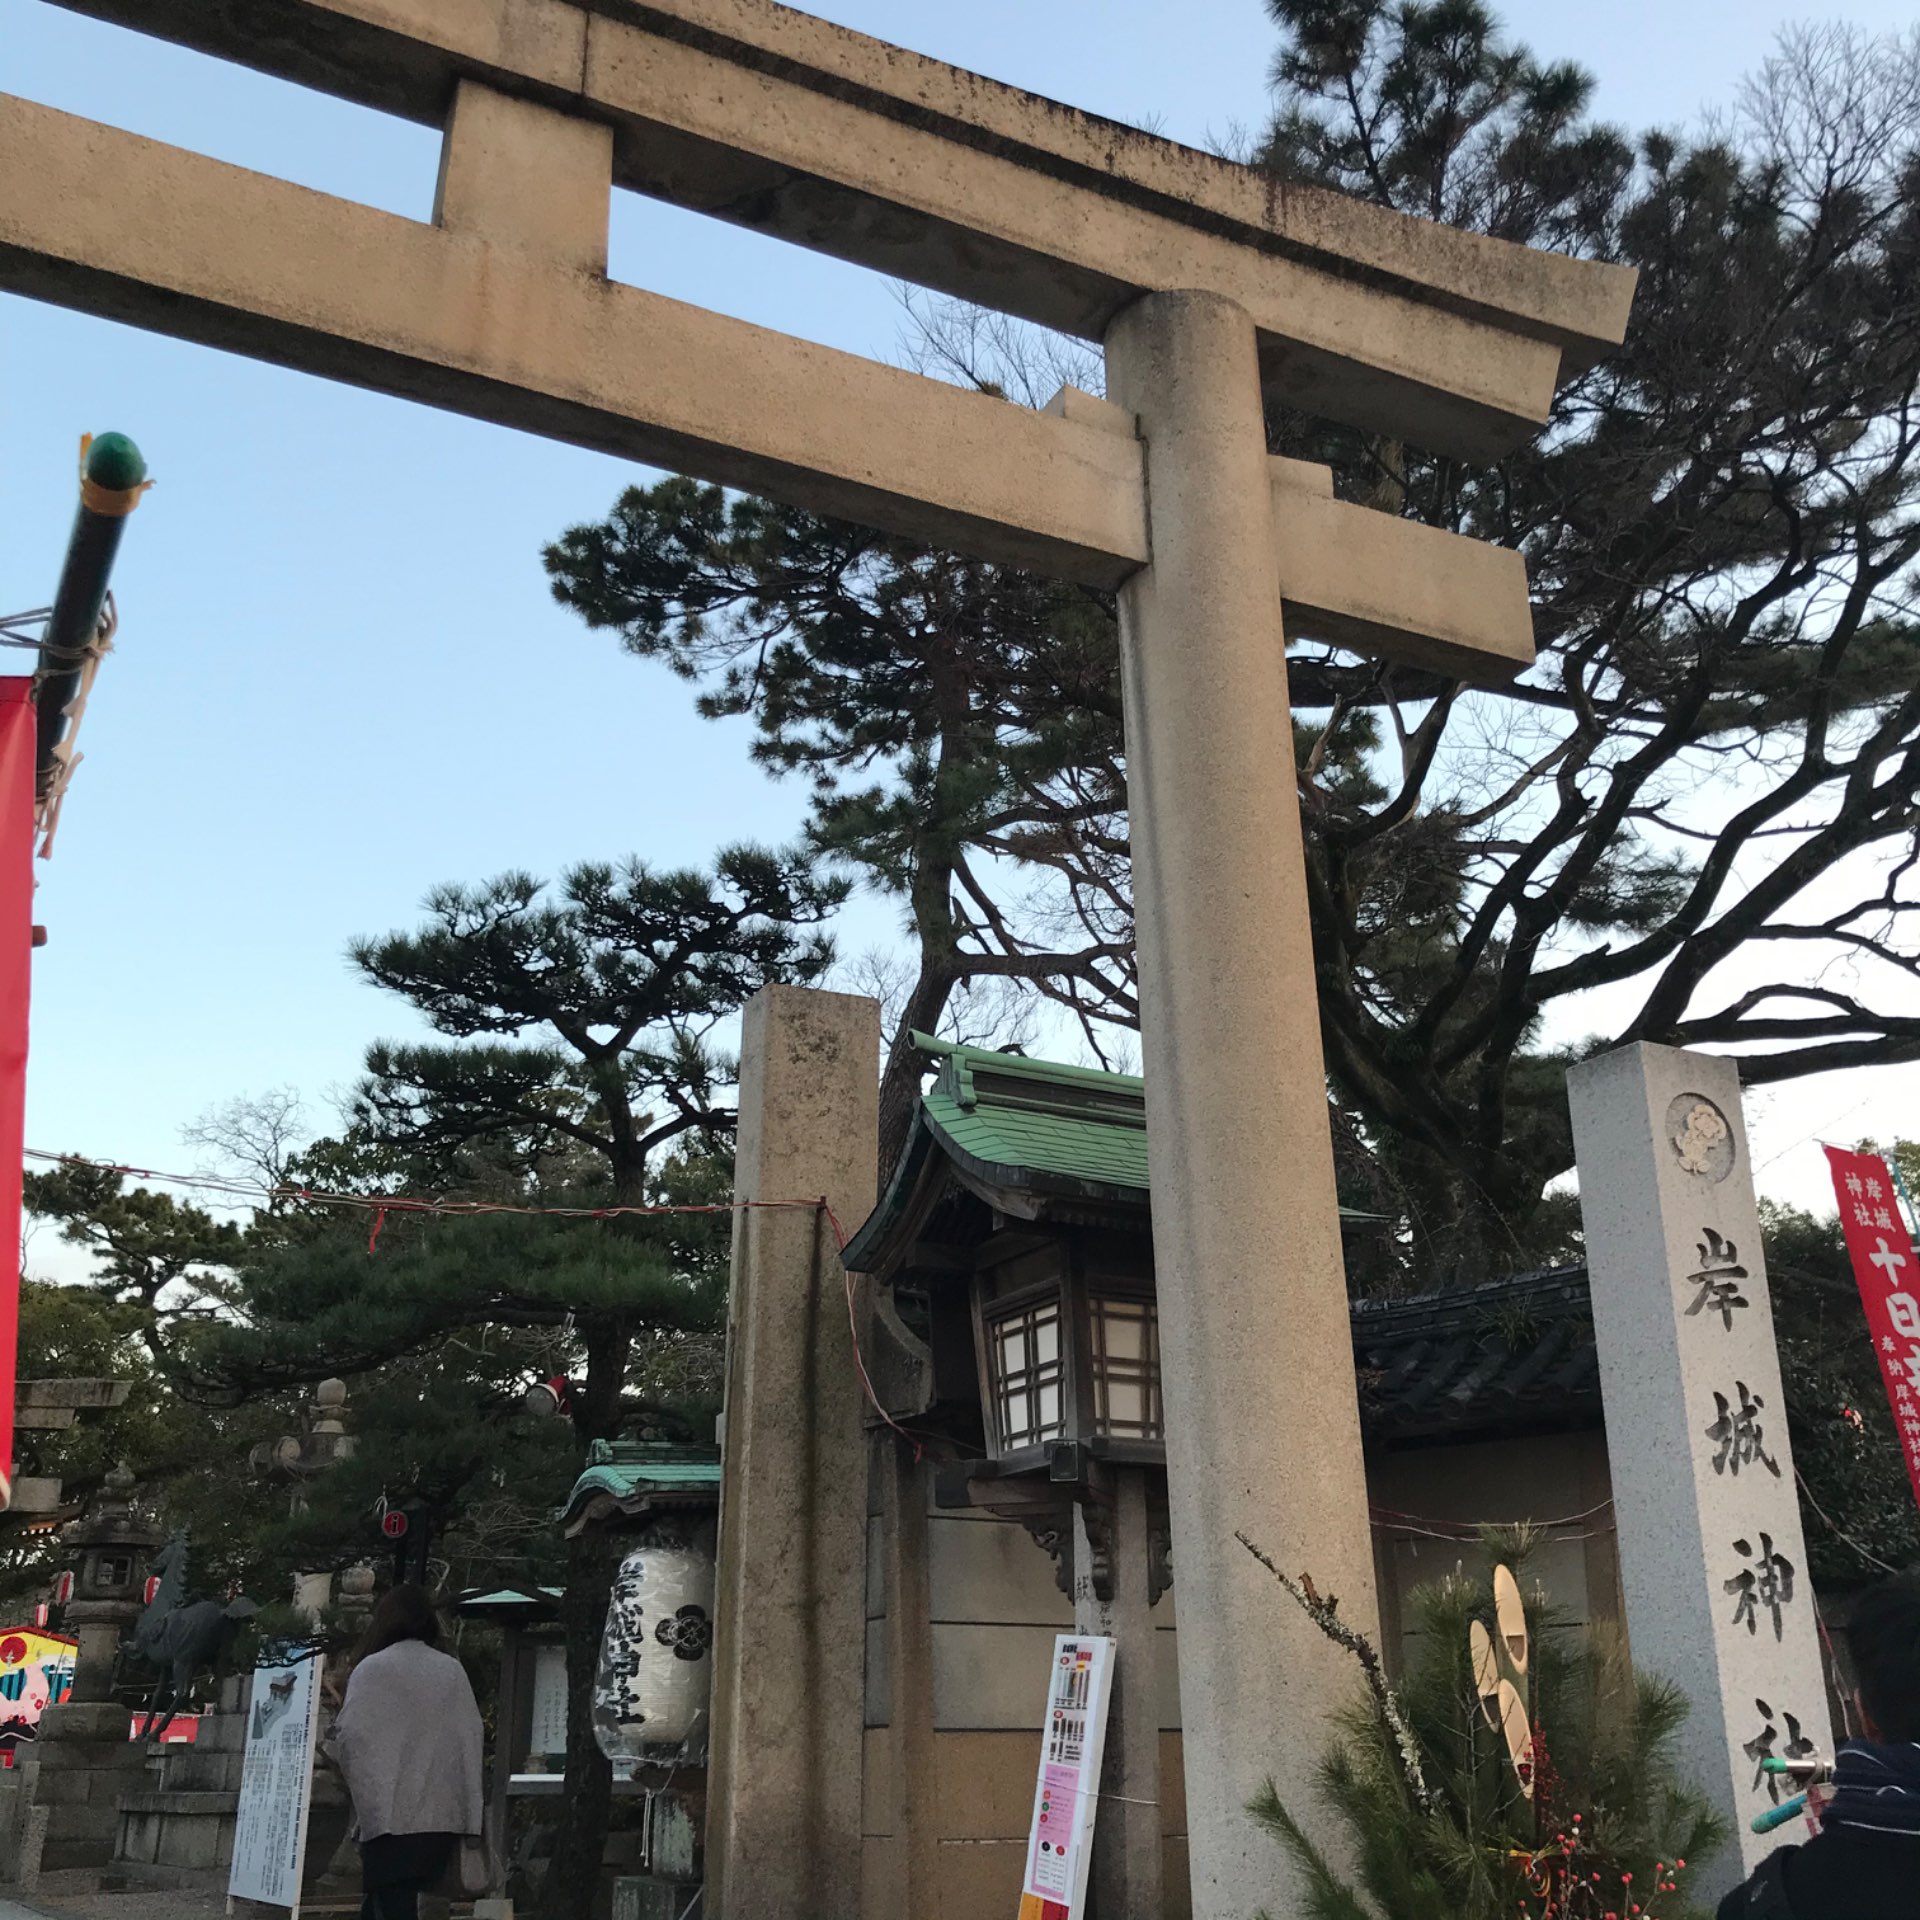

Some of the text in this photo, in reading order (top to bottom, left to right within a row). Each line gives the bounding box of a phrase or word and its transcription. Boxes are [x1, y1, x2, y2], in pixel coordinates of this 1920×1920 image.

[1845, 1171, 1875, 1228] 神社
[1865, 1176, 1896, 1233] 岸城
[1684, 1227, 1816, 1806] 岸城神社
